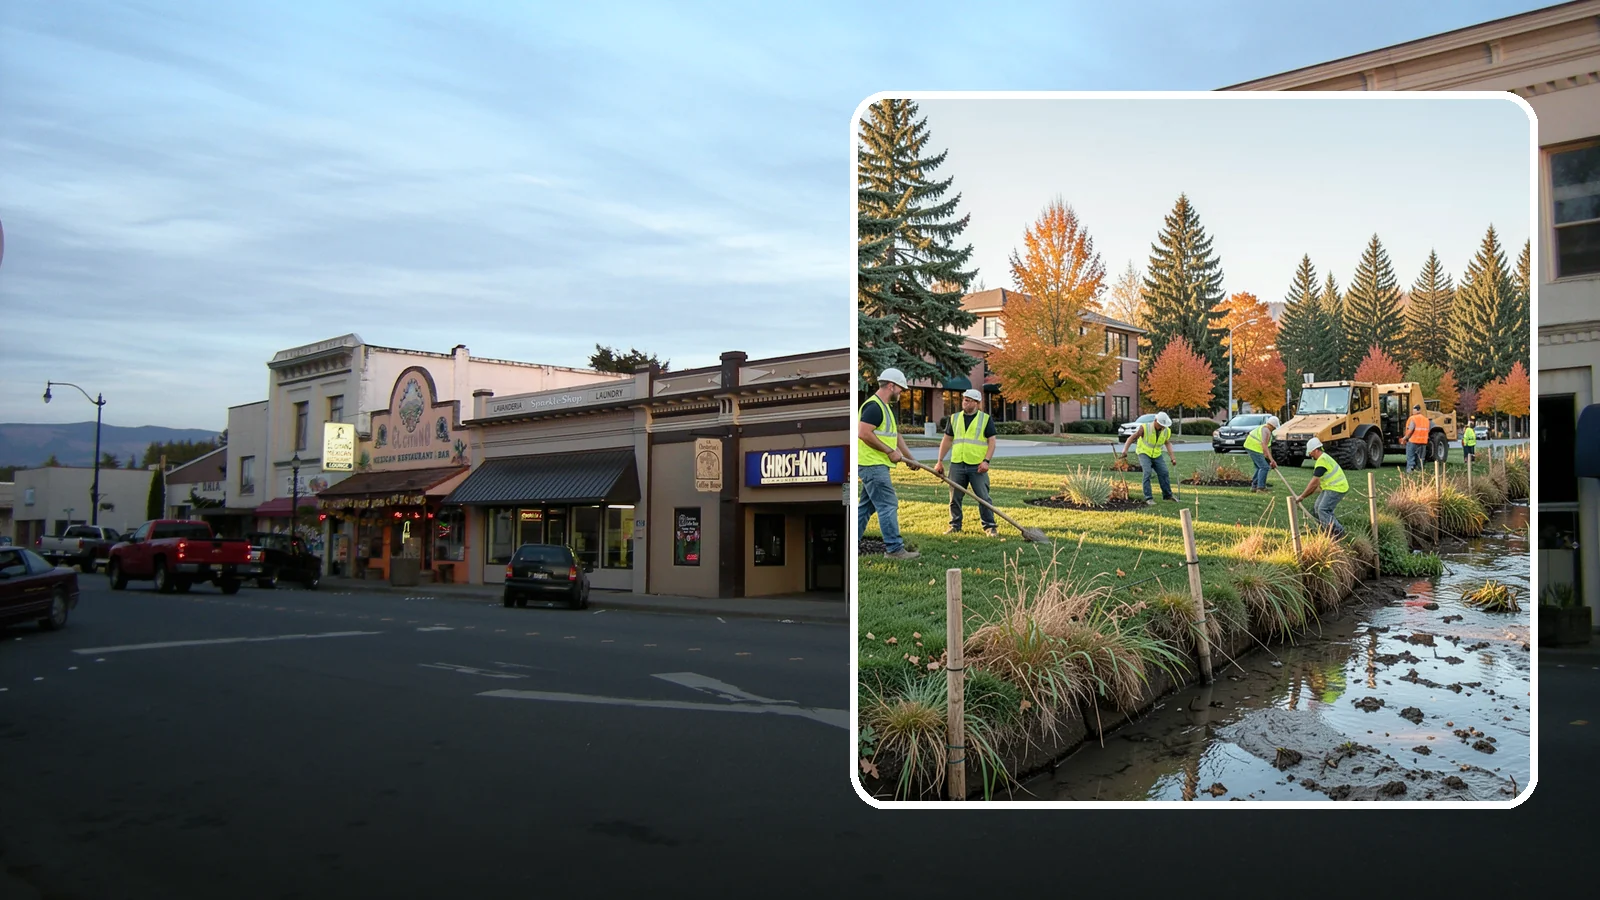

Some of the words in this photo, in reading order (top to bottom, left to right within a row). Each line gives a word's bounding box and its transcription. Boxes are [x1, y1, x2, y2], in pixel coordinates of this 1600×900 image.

[493, 402, 523, 413] LAVANDERIA
[531, 397, 561, 409] Sparkle
[561, 395, 582, 405] Shop
[595, 389, 624, 400] LAUNDRY
[392, 426, 402, 450] EL
[374, 454, 397, 464] MEXICAN
[397, 451, 433, 463] RESTAURANT
[438, 450, 450, 460] BAR
[761, 452, 797, 478] CHRIST
[799, 450, 827, 477] KING
